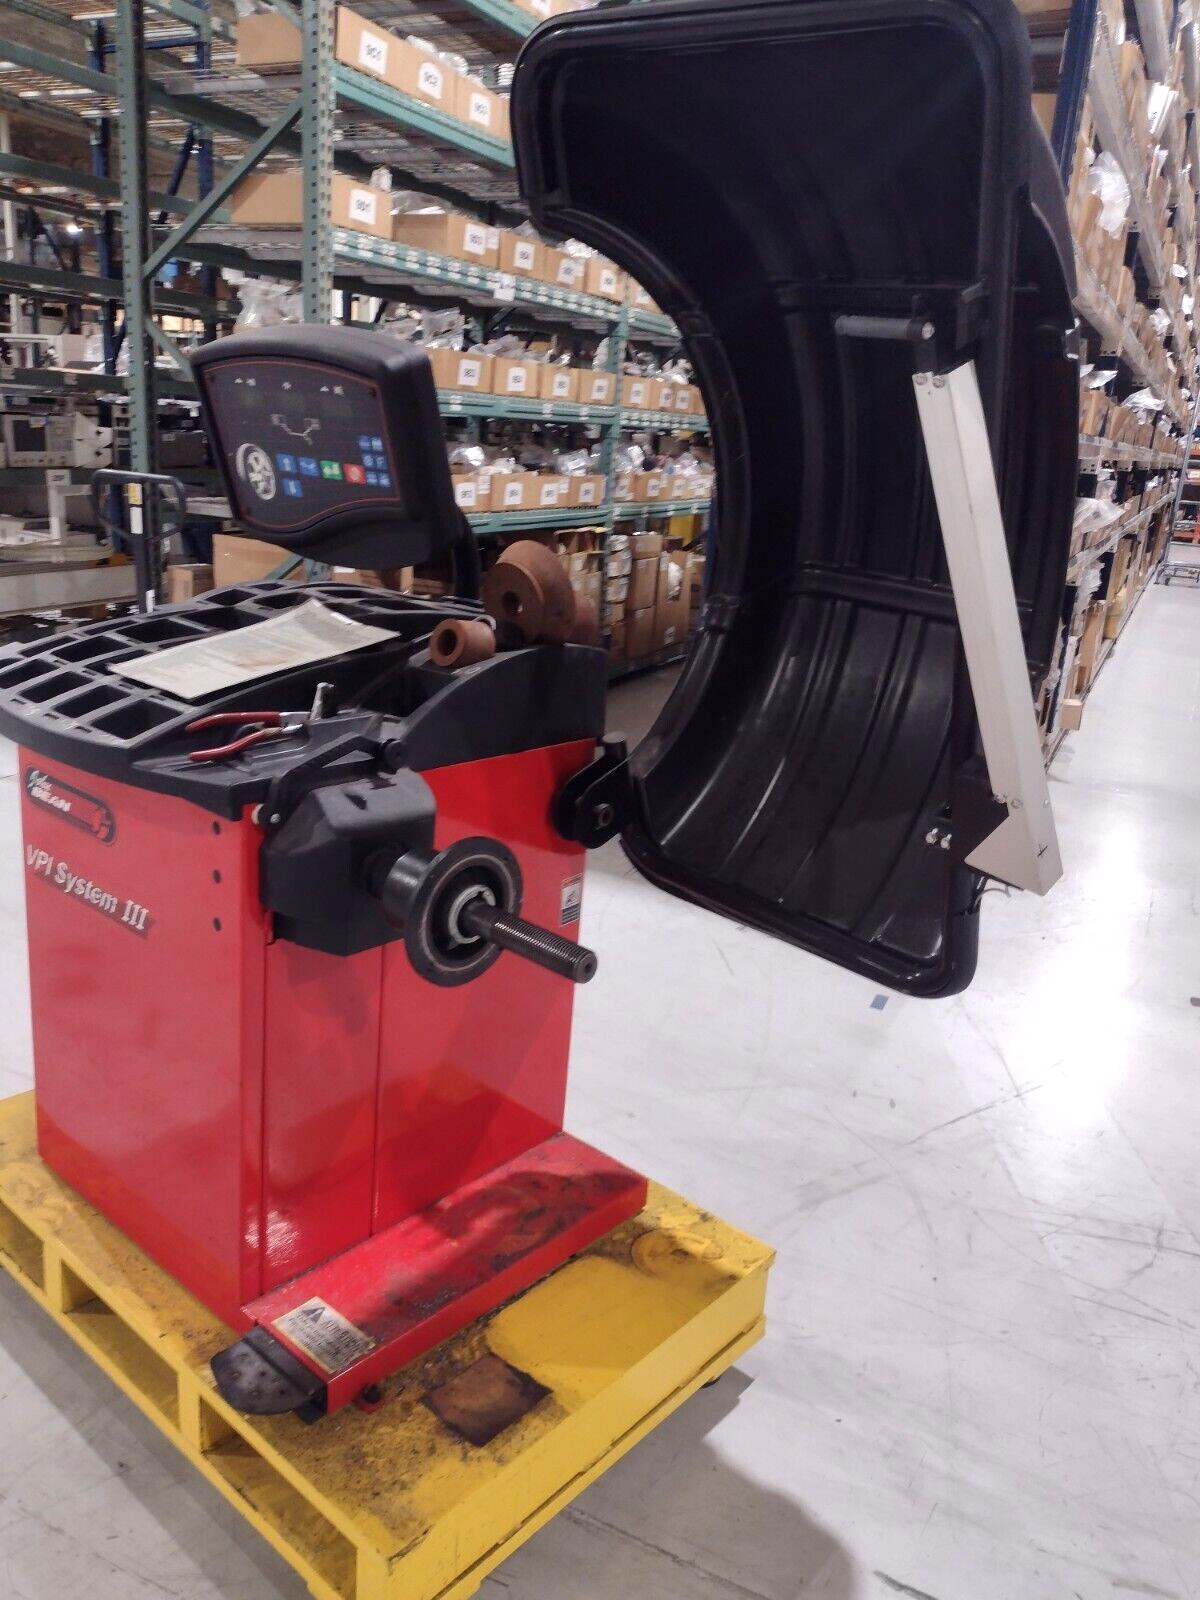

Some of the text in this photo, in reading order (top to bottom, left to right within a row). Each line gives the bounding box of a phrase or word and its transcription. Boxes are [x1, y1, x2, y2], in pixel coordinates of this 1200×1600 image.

[26, 844, 150, 930] VPI System III
